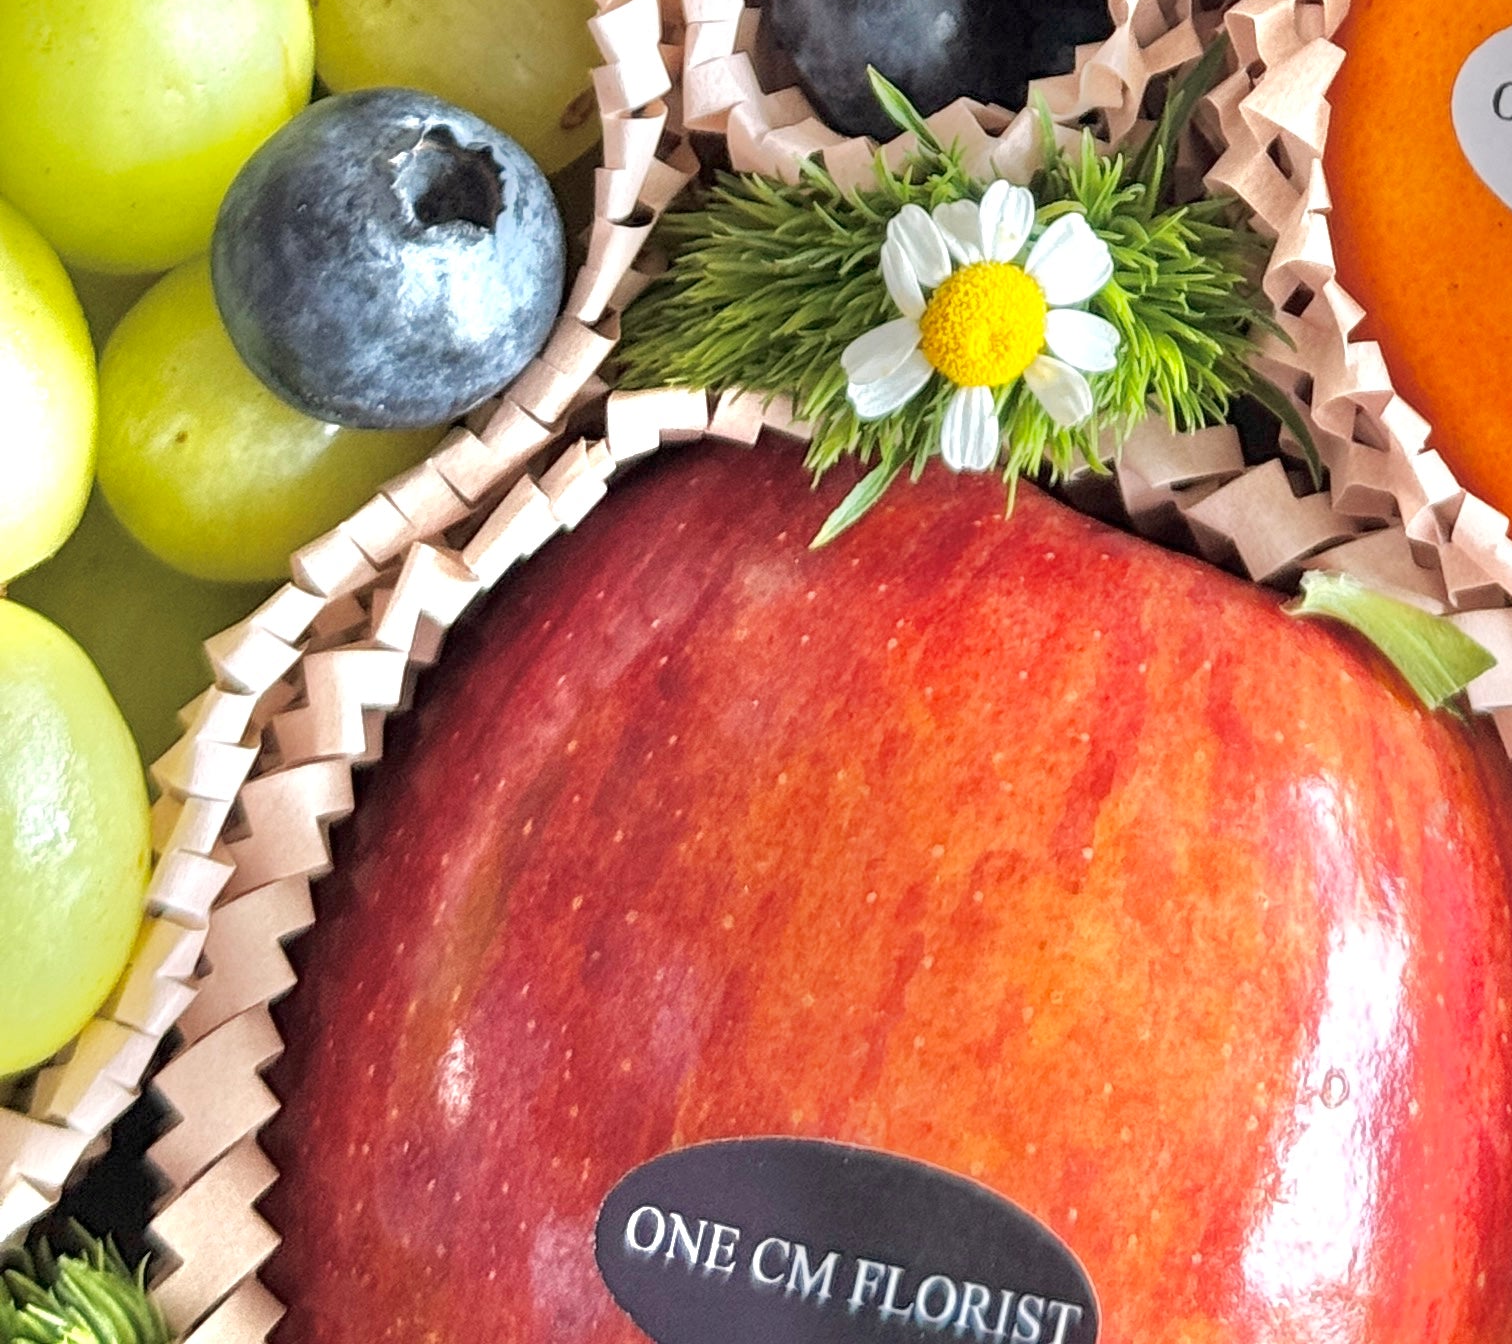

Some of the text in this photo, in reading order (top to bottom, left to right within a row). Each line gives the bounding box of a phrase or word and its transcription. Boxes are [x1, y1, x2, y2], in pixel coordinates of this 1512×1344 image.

[625, 1205, 1083, 1344] ONE CM FLORIST
